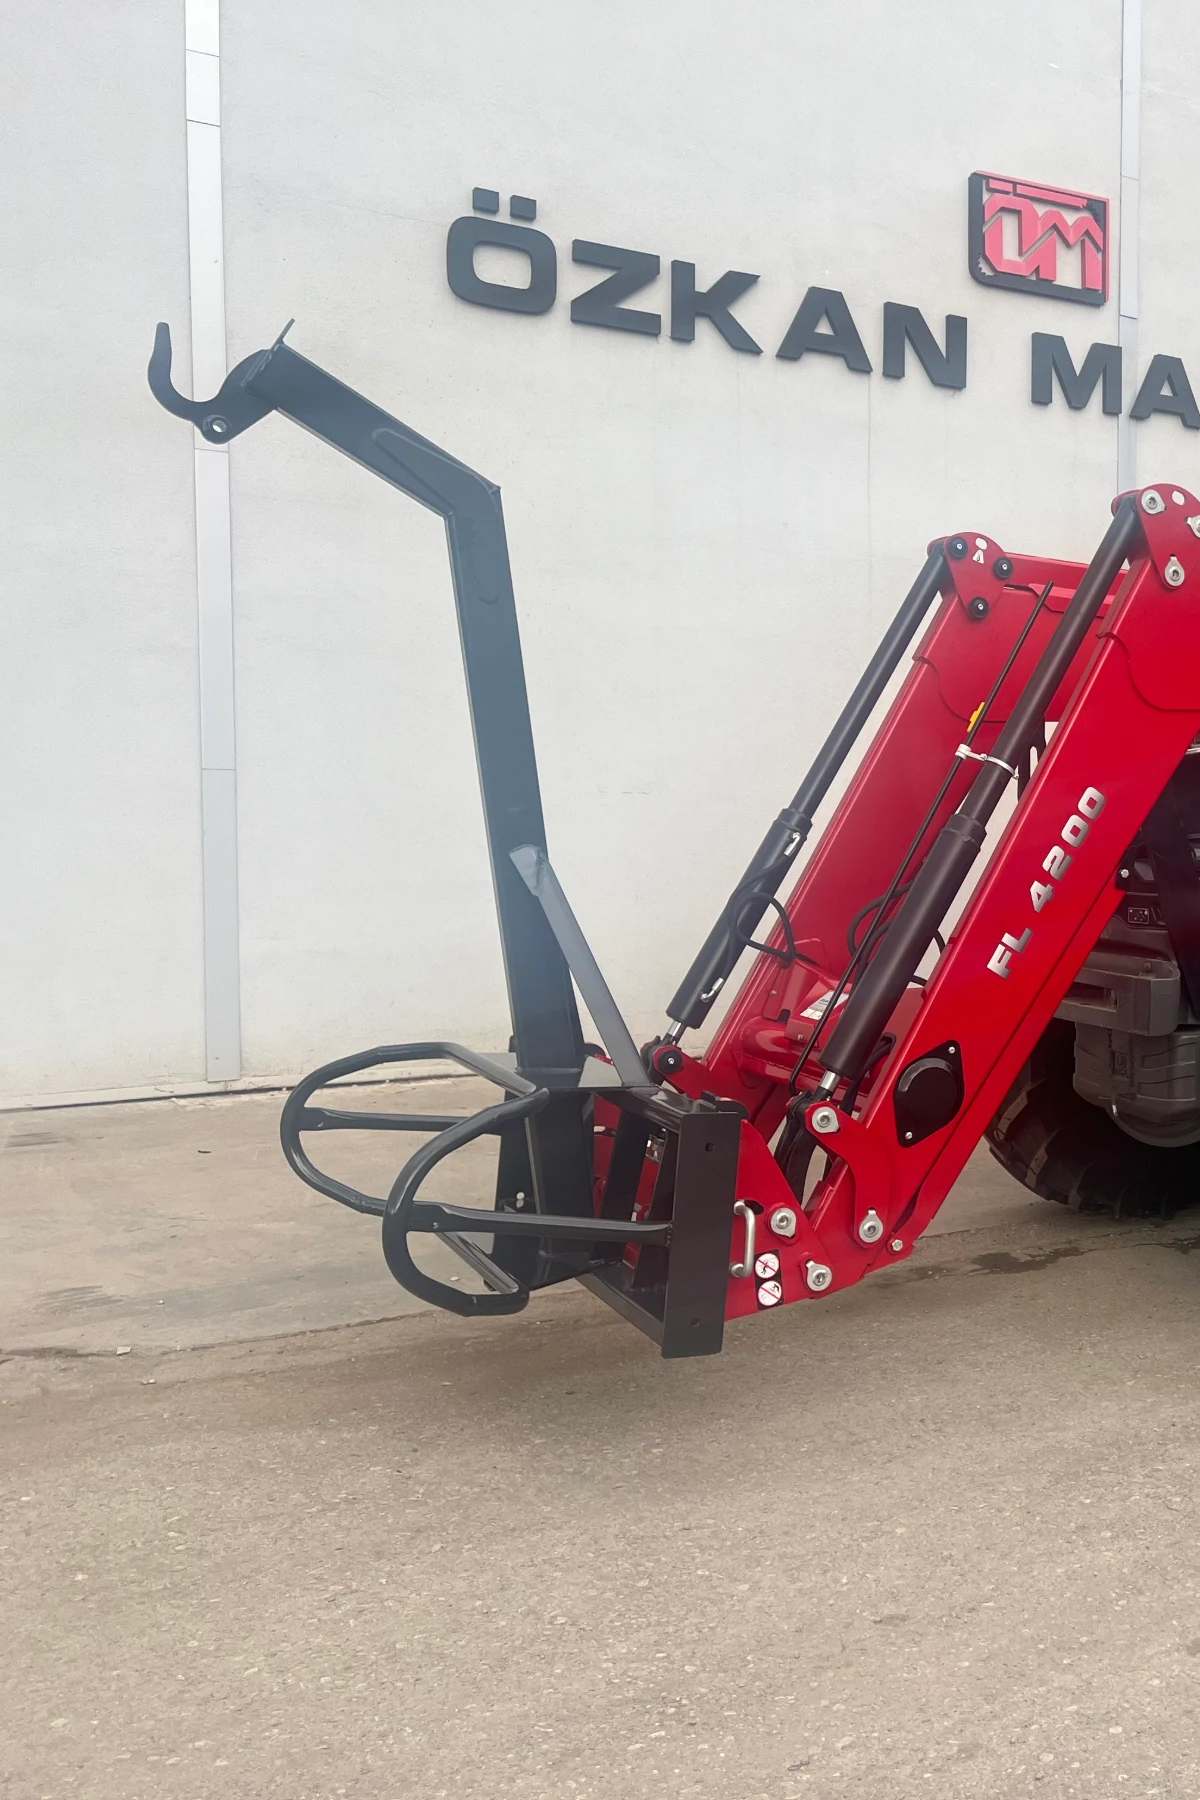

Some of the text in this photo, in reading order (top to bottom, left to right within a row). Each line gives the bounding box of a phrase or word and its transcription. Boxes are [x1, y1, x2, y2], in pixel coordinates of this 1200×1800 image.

[446, 186, 968, 391] ÖZKAN
[987, 786, 1106, 980] FL 4200
